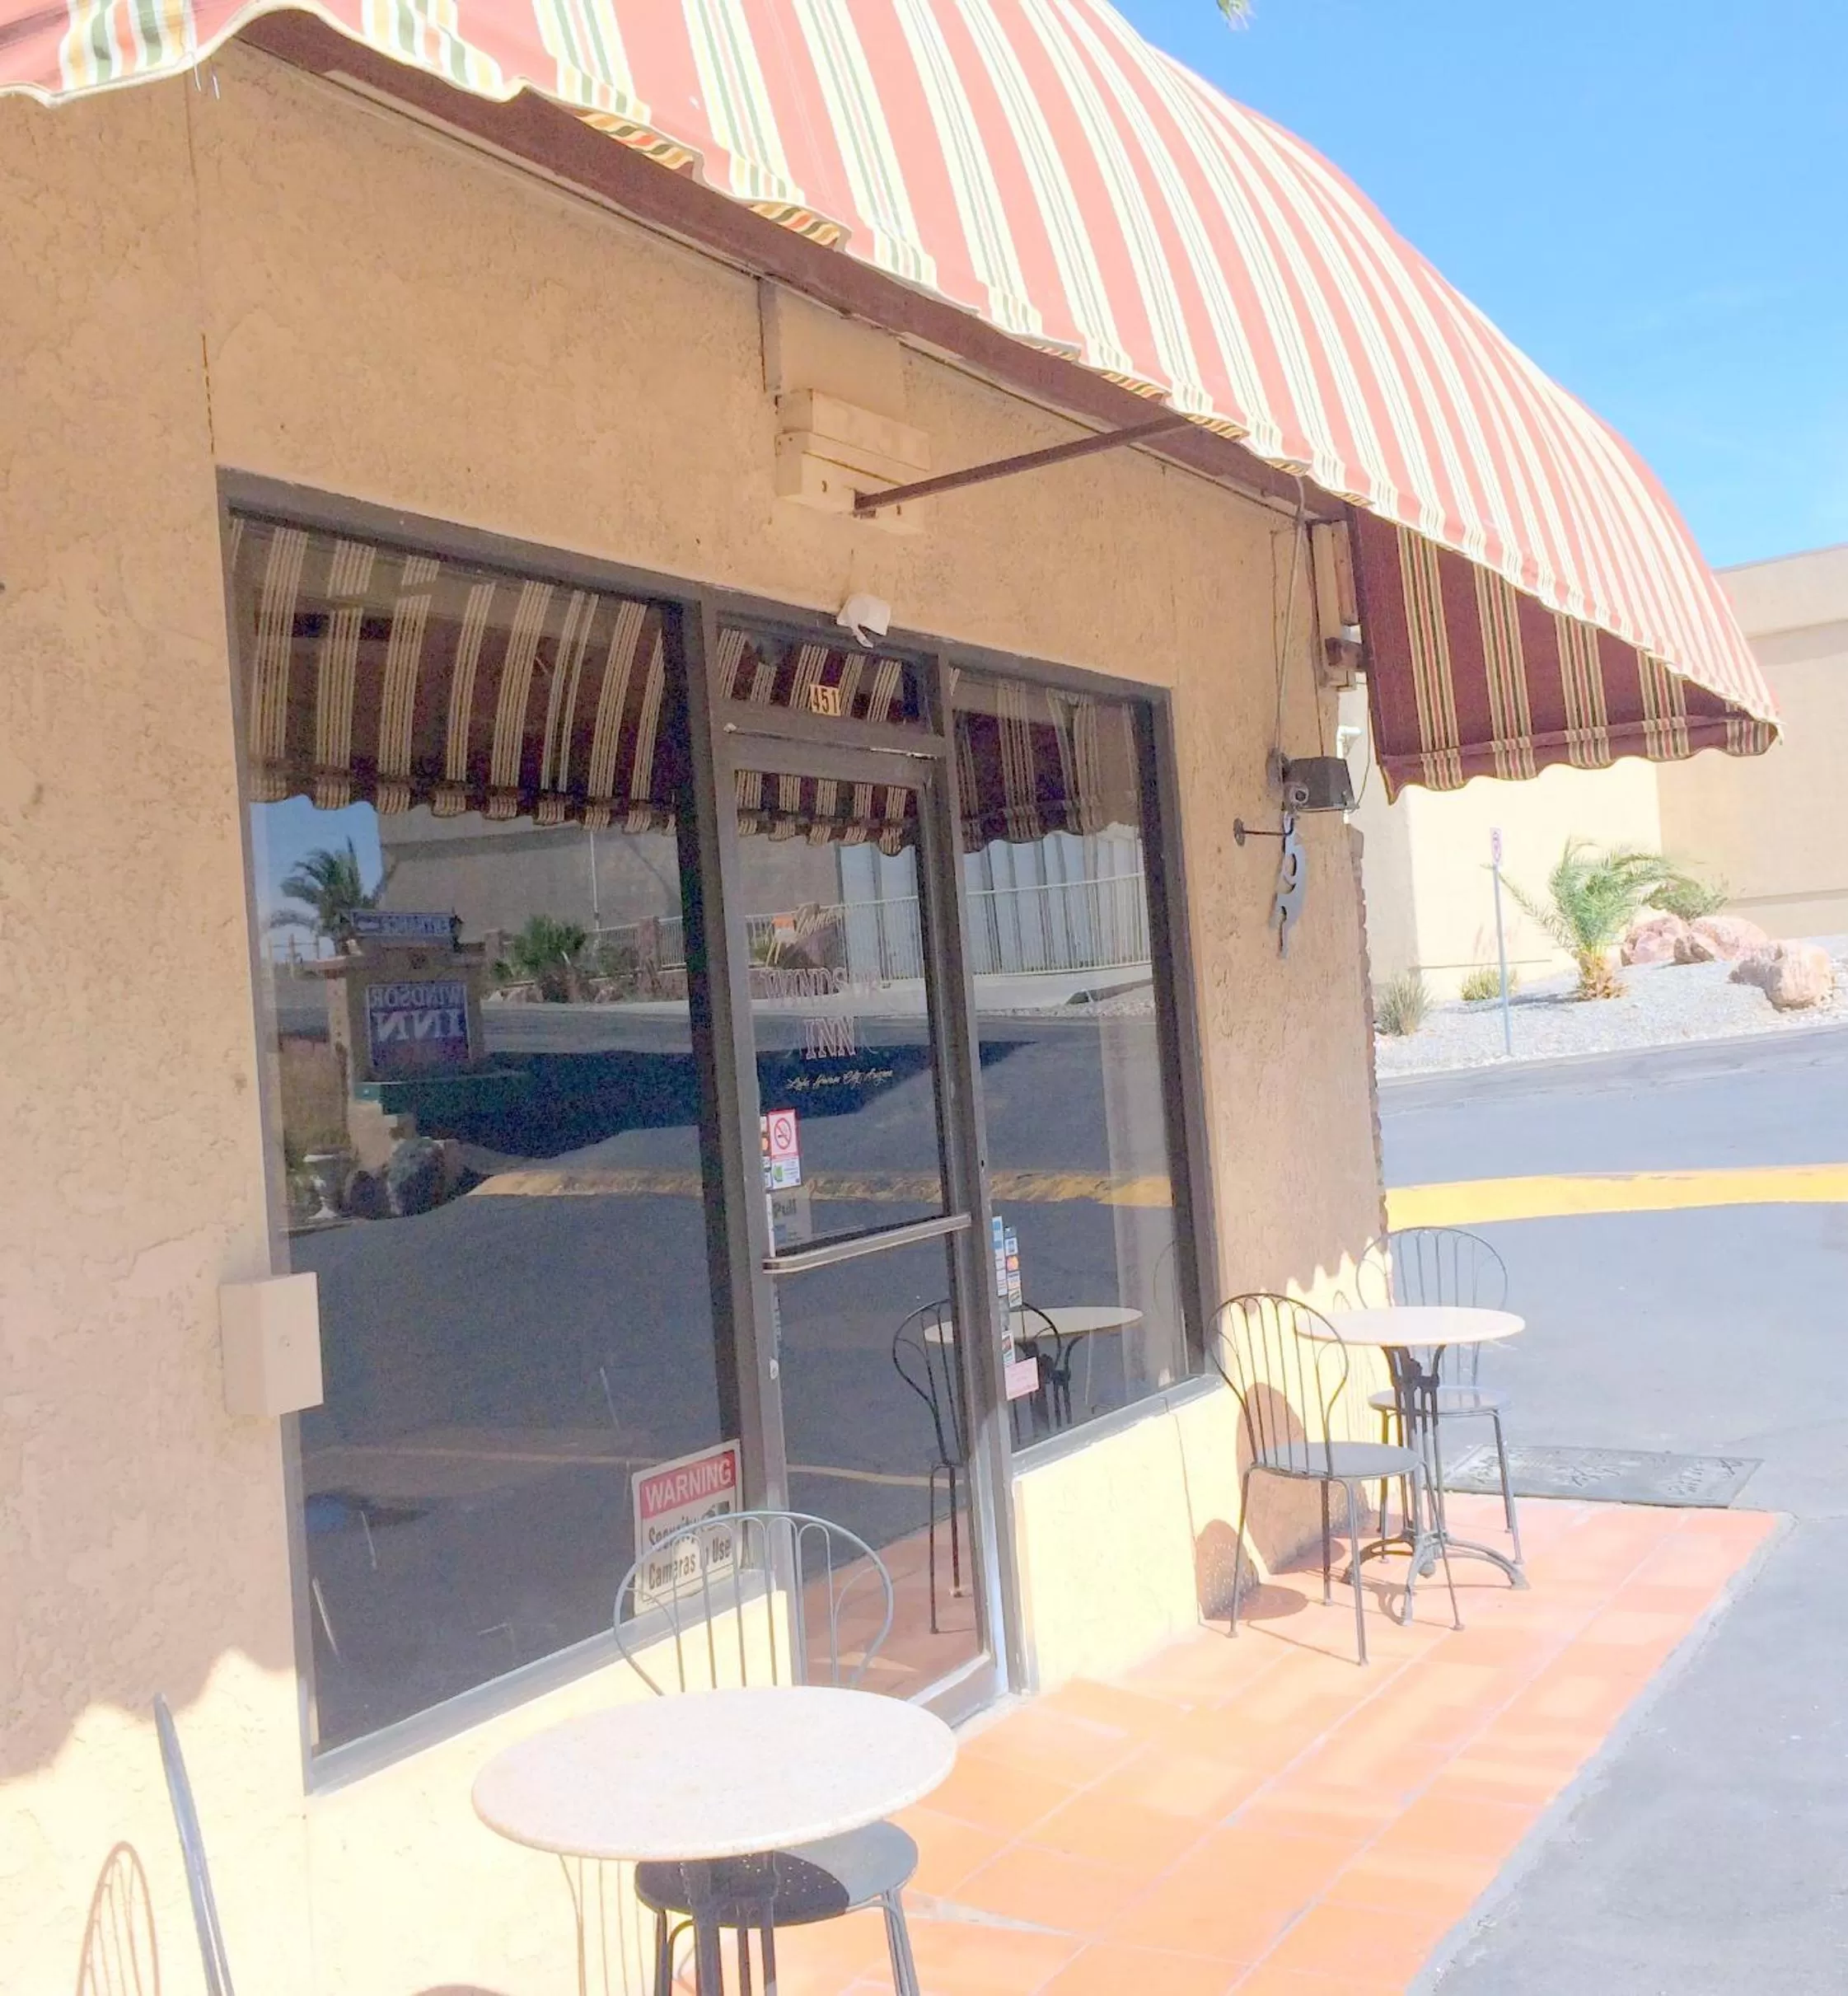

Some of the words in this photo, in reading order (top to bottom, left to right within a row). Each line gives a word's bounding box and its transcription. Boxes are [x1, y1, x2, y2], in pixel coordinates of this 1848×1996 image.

[813, 686, 838, 713] 451
[804, 1016, 857, 1060] INN
[644, 1459, 733, 1513] WARNING
[648, 1553, 696, 1590] Cameras
[712, 1535, 732, 1564] Use
